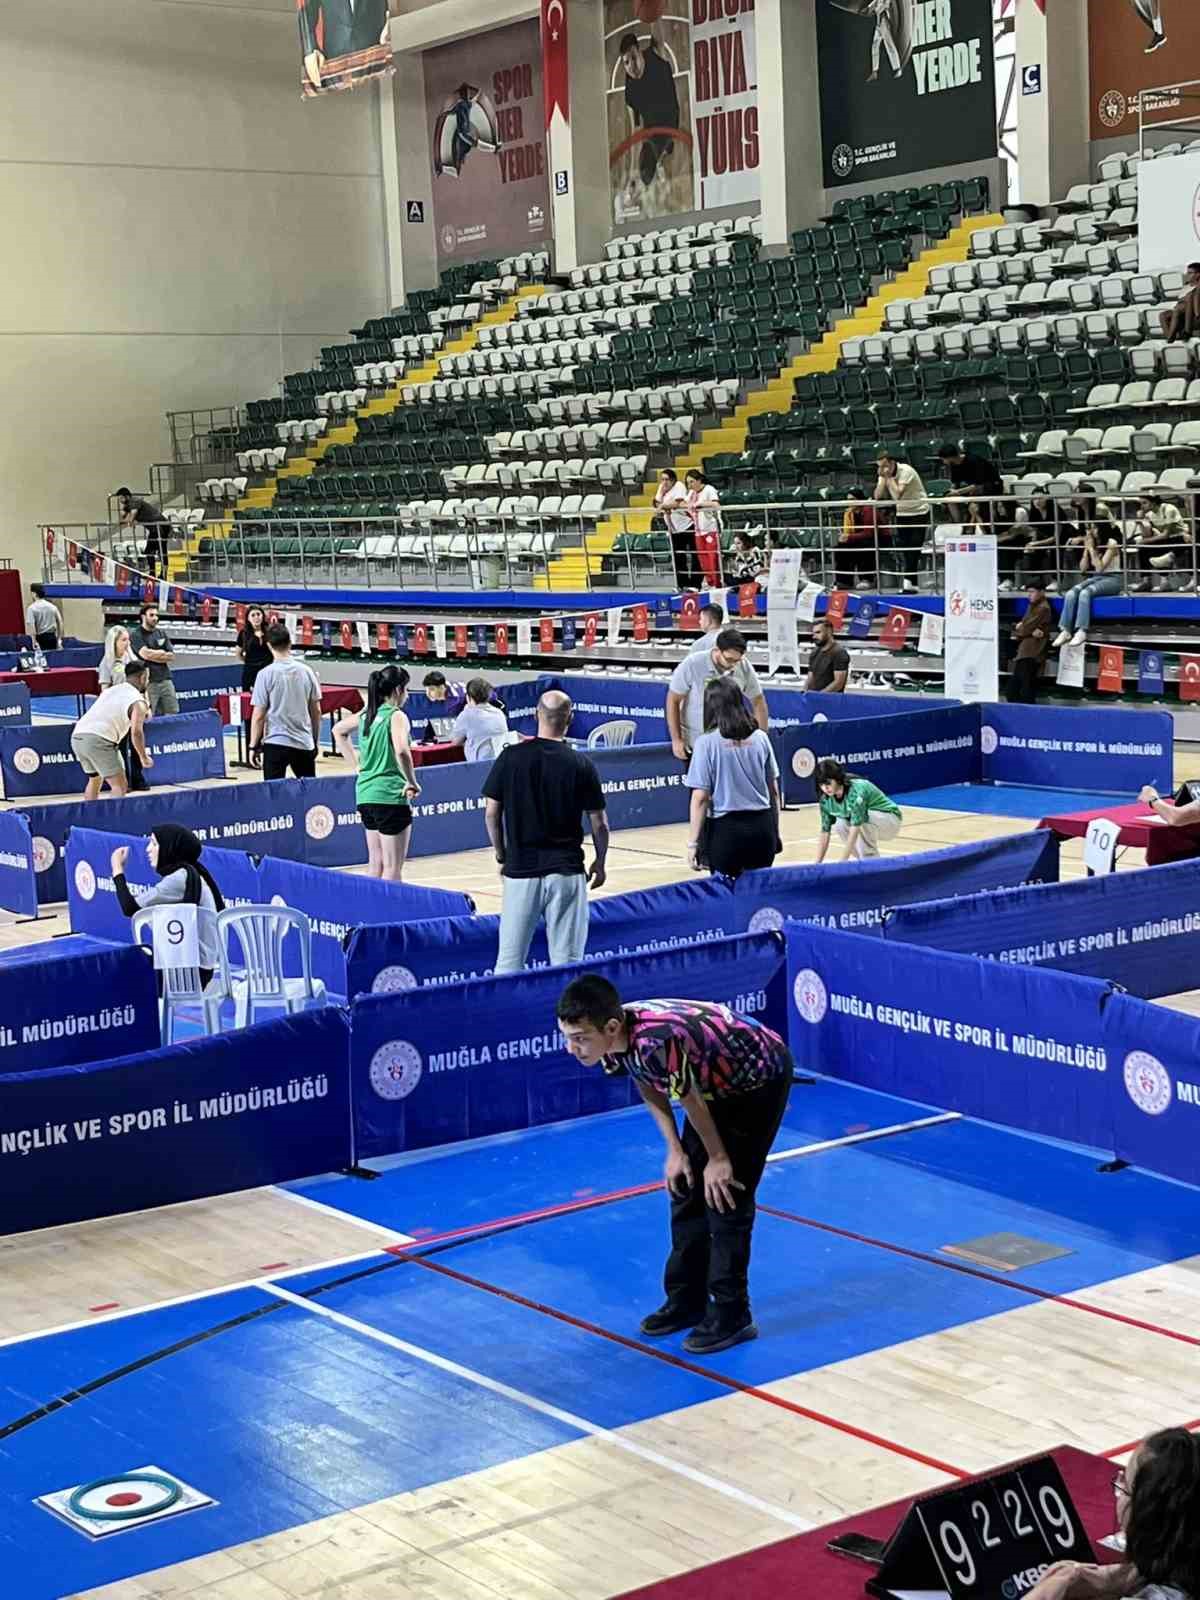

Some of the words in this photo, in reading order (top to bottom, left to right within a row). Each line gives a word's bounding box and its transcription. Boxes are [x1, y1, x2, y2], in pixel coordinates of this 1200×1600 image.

[911, 38, 982, 96] YERDE
[1024, 66, 1038, 86] C
[493, 63, 534, 105] SPOR
[695, 106, 760, 178] YÜKS
[499, 142, 545, 184] YERDE
[556, 172, 566, 188] B
[409, 202, 421, 217] A
[969, 599, 994, 612] HEMS
[42, 751, 75, 764] MUĞLA
[163, 737, 217, 754] MÜDÜRLÜĞÜ
[848, 747, 881, 765] GENÇLİK
[883, 748, 894, 759] VE
[895, 745, 916, 758] SPOR
[926, 734, 973, 753] MÜDÜRLÜĞÜ
[1000, 736, 1026, 748] MUĞLA
[1028, 738, 1062, 752] GENÇLİK
[1063, 741, 1073, 751] VE
[1075, 742, 1097, 753] SPOR
[1109, 743, 1163, 756] MÜDÜRLÜĞÜ
[601, 780, 626, 794] UĞLA
[627, 776, 666, 792] GENÇLİK
[667, 775, 680, 786] VE
[337, 811, 362, 825] MUĞ
[421, 805, 435, 816] VE
[437, 801, 464, 815] SPOR
[466, 800, 475, 810] İL
[210, 825, 221, 839] İL
[223, 814, 294, 837] MÜDÜRLÜĞÜ
[1093, 828, 1110, 851] 10
[840, 904, 893, 929] GENÇLİ
[167, 919, 185, 945] 9
[999, 941, 1056, 965] GENÇLİK
[1058, 940, 1076, 956] VE
[1079, 932, 1115, 953] SPOR
[1117, 926, 1129, 945] İL
[1131, 912, 1200, 943] MÜDÜRLÜĞ
[0, 1026, 18, 1047] İL
[22, 1004, 136, 1044] MÜDÜRLÜĞÜ
[830, 993, 874, 1021] MUĞLA
[876, 1007, 931, 1034] GENÇLİK
[934, 1020, 951, 1039] VE
[955, 1027, 991, 1049] SPOR
[995, 1028, 1009, 1052] İL
[1012, 1033, 1107, 1072] MÜDÜRLÜĞÜ
[429, 1045, 492, 1073] MUĞLA
[1, 1122, 69, 1156] NÇLİK
[73, 1118, 102, 1143] VE
[109, 1107, 167, 1137] SPOR
[174, 1100, 193, 1124] İL
[199, 1073, 329, 1121] MÜDÜRLÜĞÜ
[939, 1520, 976, 1586] 9
[971, 1500, 1001, 1548] 2
[1003, 1489, 1033, 1537] 2
[1038, 1485, 1075, 1549] 9
